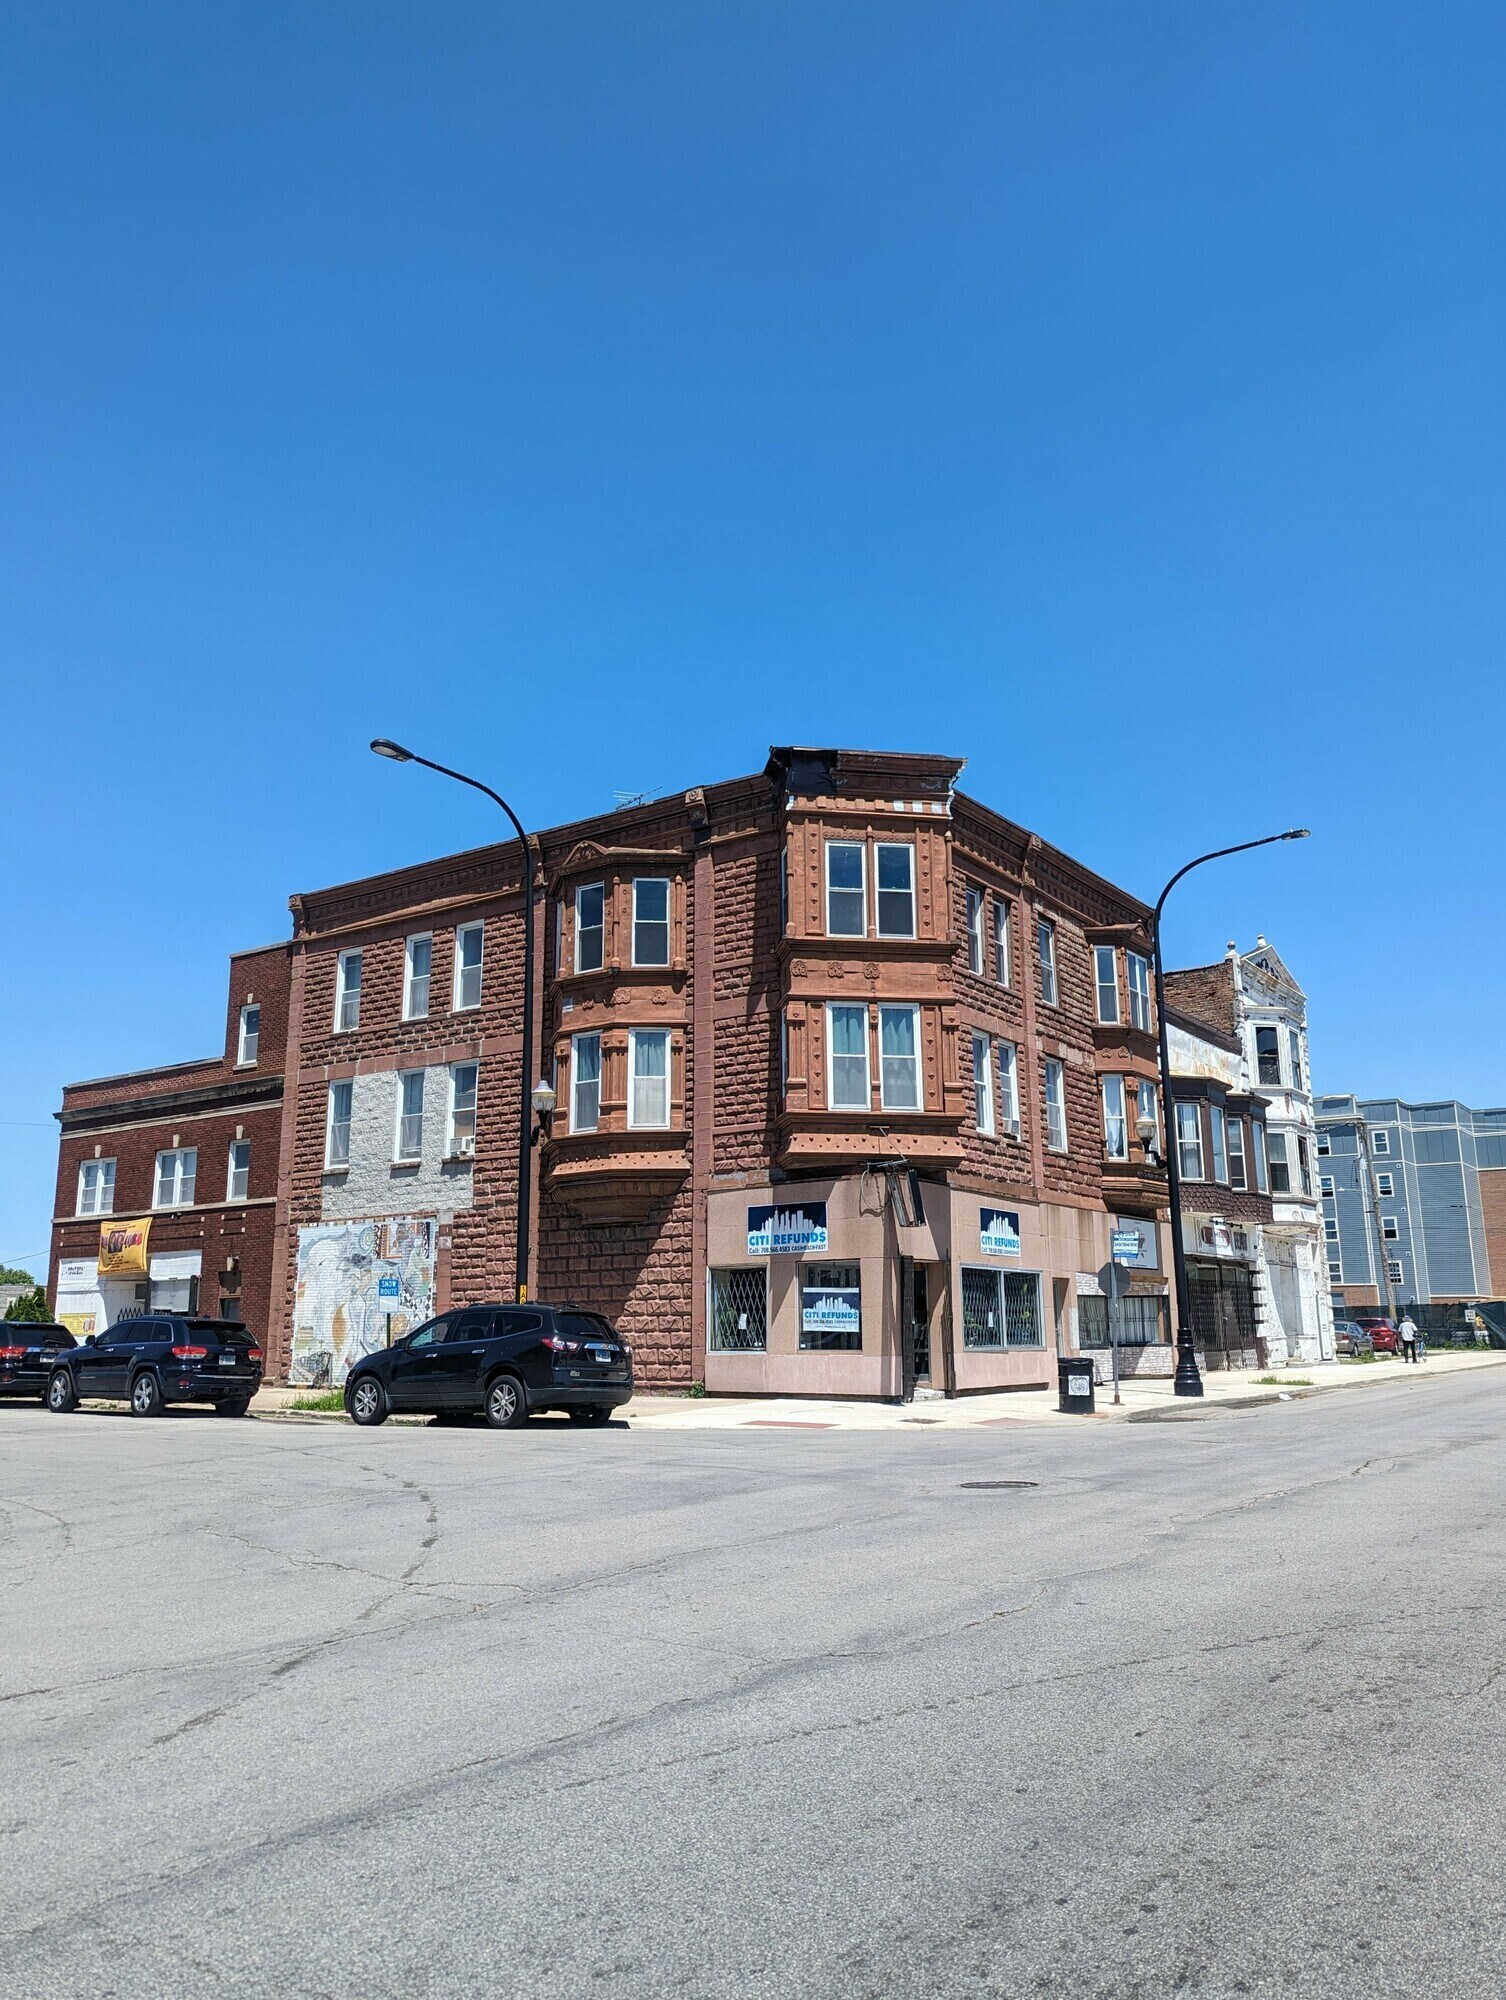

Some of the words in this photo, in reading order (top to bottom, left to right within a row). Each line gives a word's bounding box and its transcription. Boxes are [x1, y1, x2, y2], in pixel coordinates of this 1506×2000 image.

[749, 1235, 769, 1246] CITI
[981, 1235, 993, 1246] CITI
[804, 1311, 819, 1319] CITI
